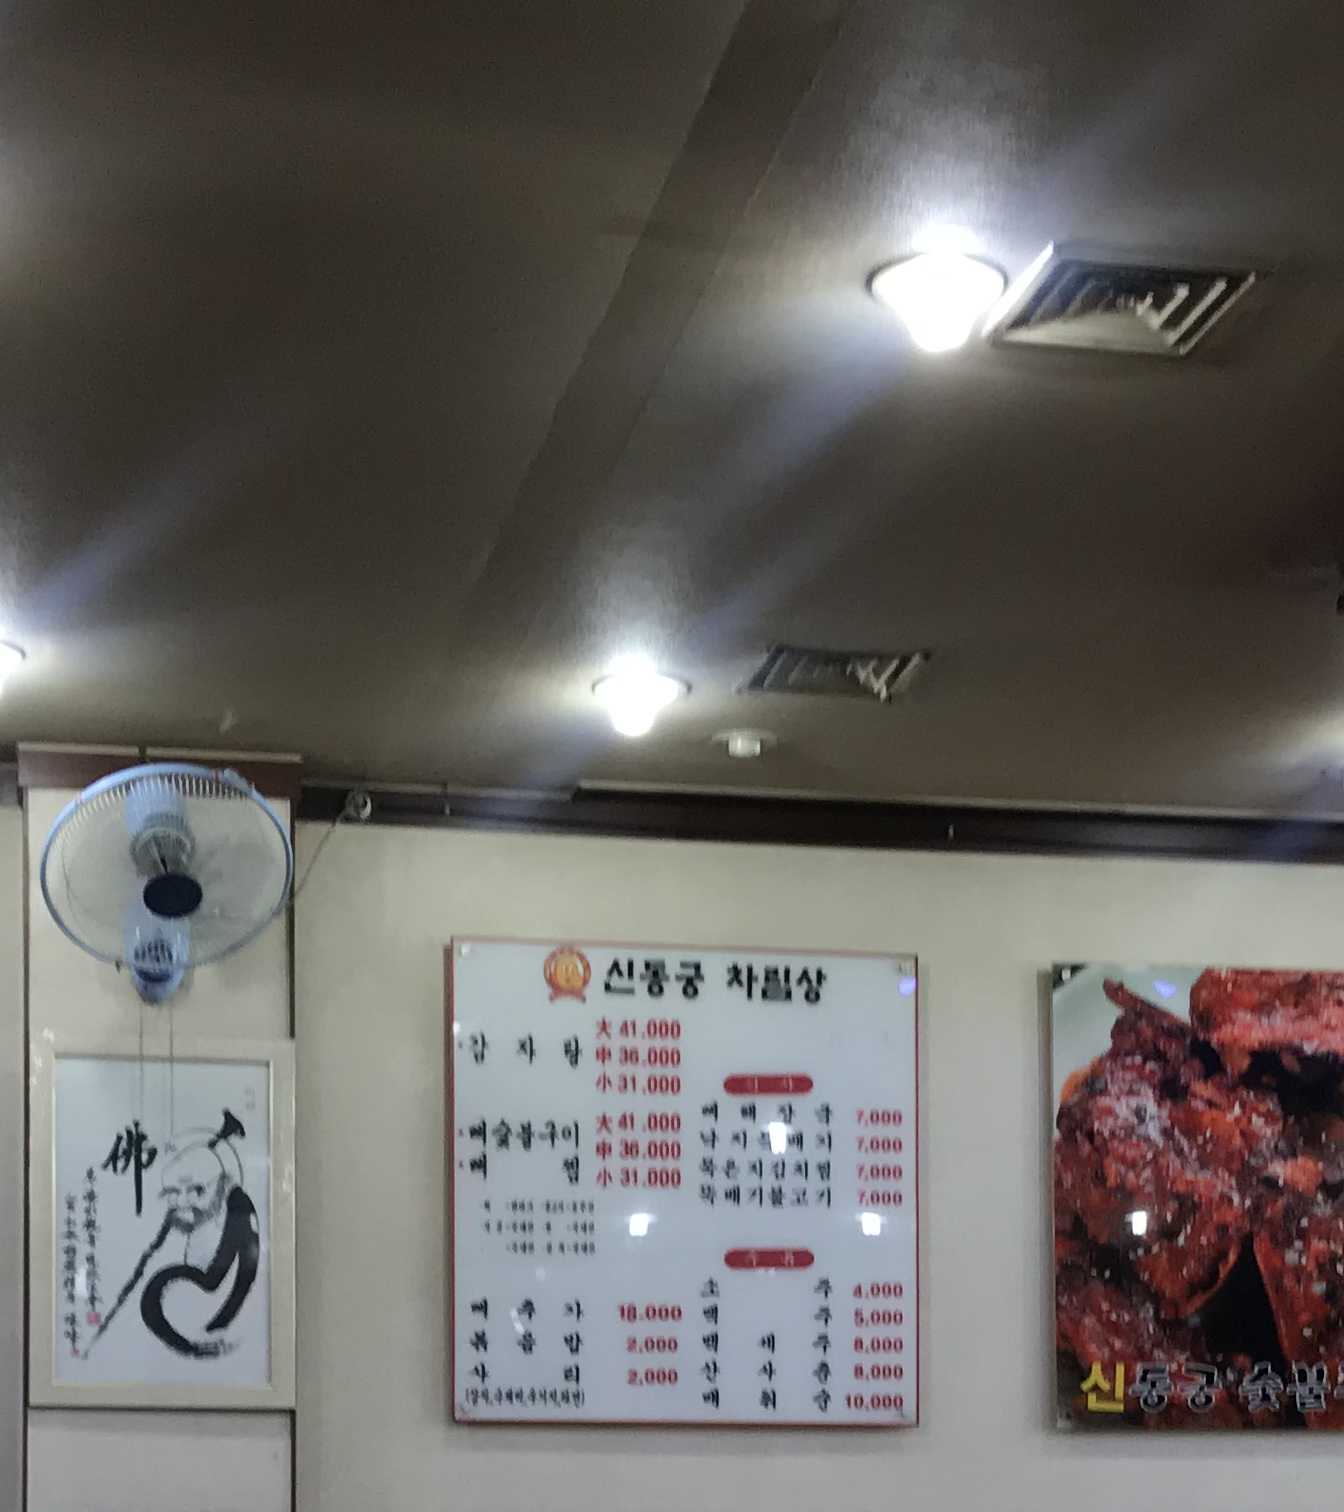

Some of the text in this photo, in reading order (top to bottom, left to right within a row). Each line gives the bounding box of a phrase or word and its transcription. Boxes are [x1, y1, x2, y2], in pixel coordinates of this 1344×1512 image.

[604, 957, 827, 1005] 신동궁 차림상
[1080, 1361, 1220, 1414] 신동궁
